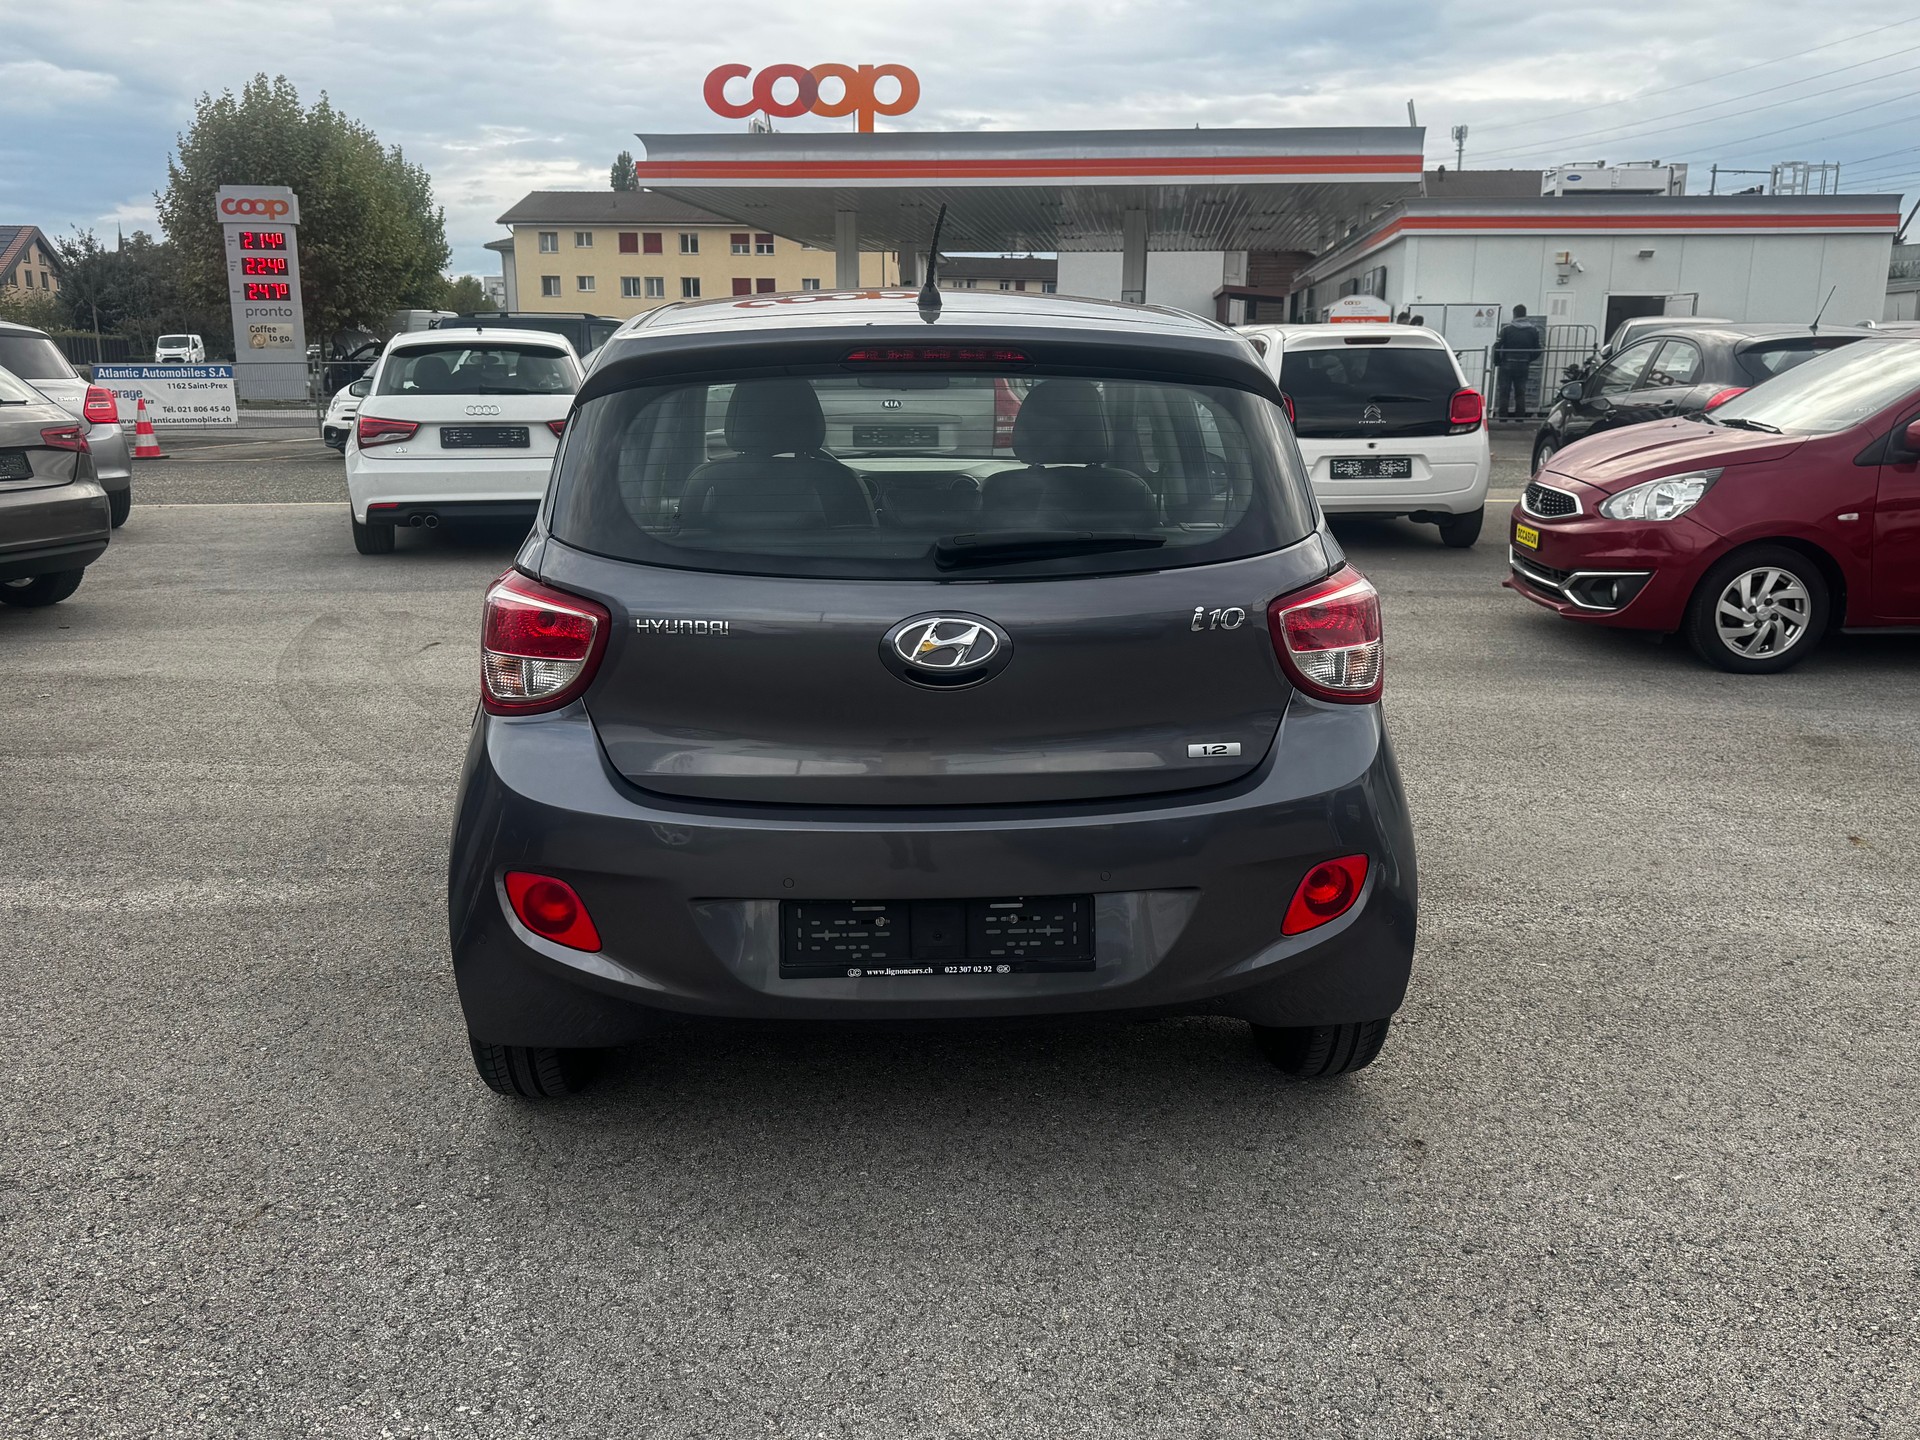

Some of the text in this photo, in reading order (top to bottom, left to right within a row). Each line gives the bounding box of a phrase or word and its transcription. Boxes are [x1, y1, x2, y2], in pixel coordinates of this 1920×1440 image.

[703, 63, 920, 133] coop
[221, 198, 289, 220] coop
[245, 306, 293, 318] pronto
[249, 325, 277, 333] Coffee
[269, 334, 293, 343] to go.
[98, 367, 229, 378] Atlantic Automobiles S.A.
[167, 382, 187, 390] 1162
[107, 388, 143, 401] arage
[884, 400, 900, 408] KIA
[1190, 606, 1245, 632] i10
[636, 619, 729, 635] HYUNDAI
[1202, 745, 1228, 756] 1.2
[866, 967, 933, 976] www.lignoncars.ch
[944, 966, 958, 974] 022
[959, 965, 972, 973] 307
[973, 965, 982, 973] 02
[983, 965, 993, 973] 92
